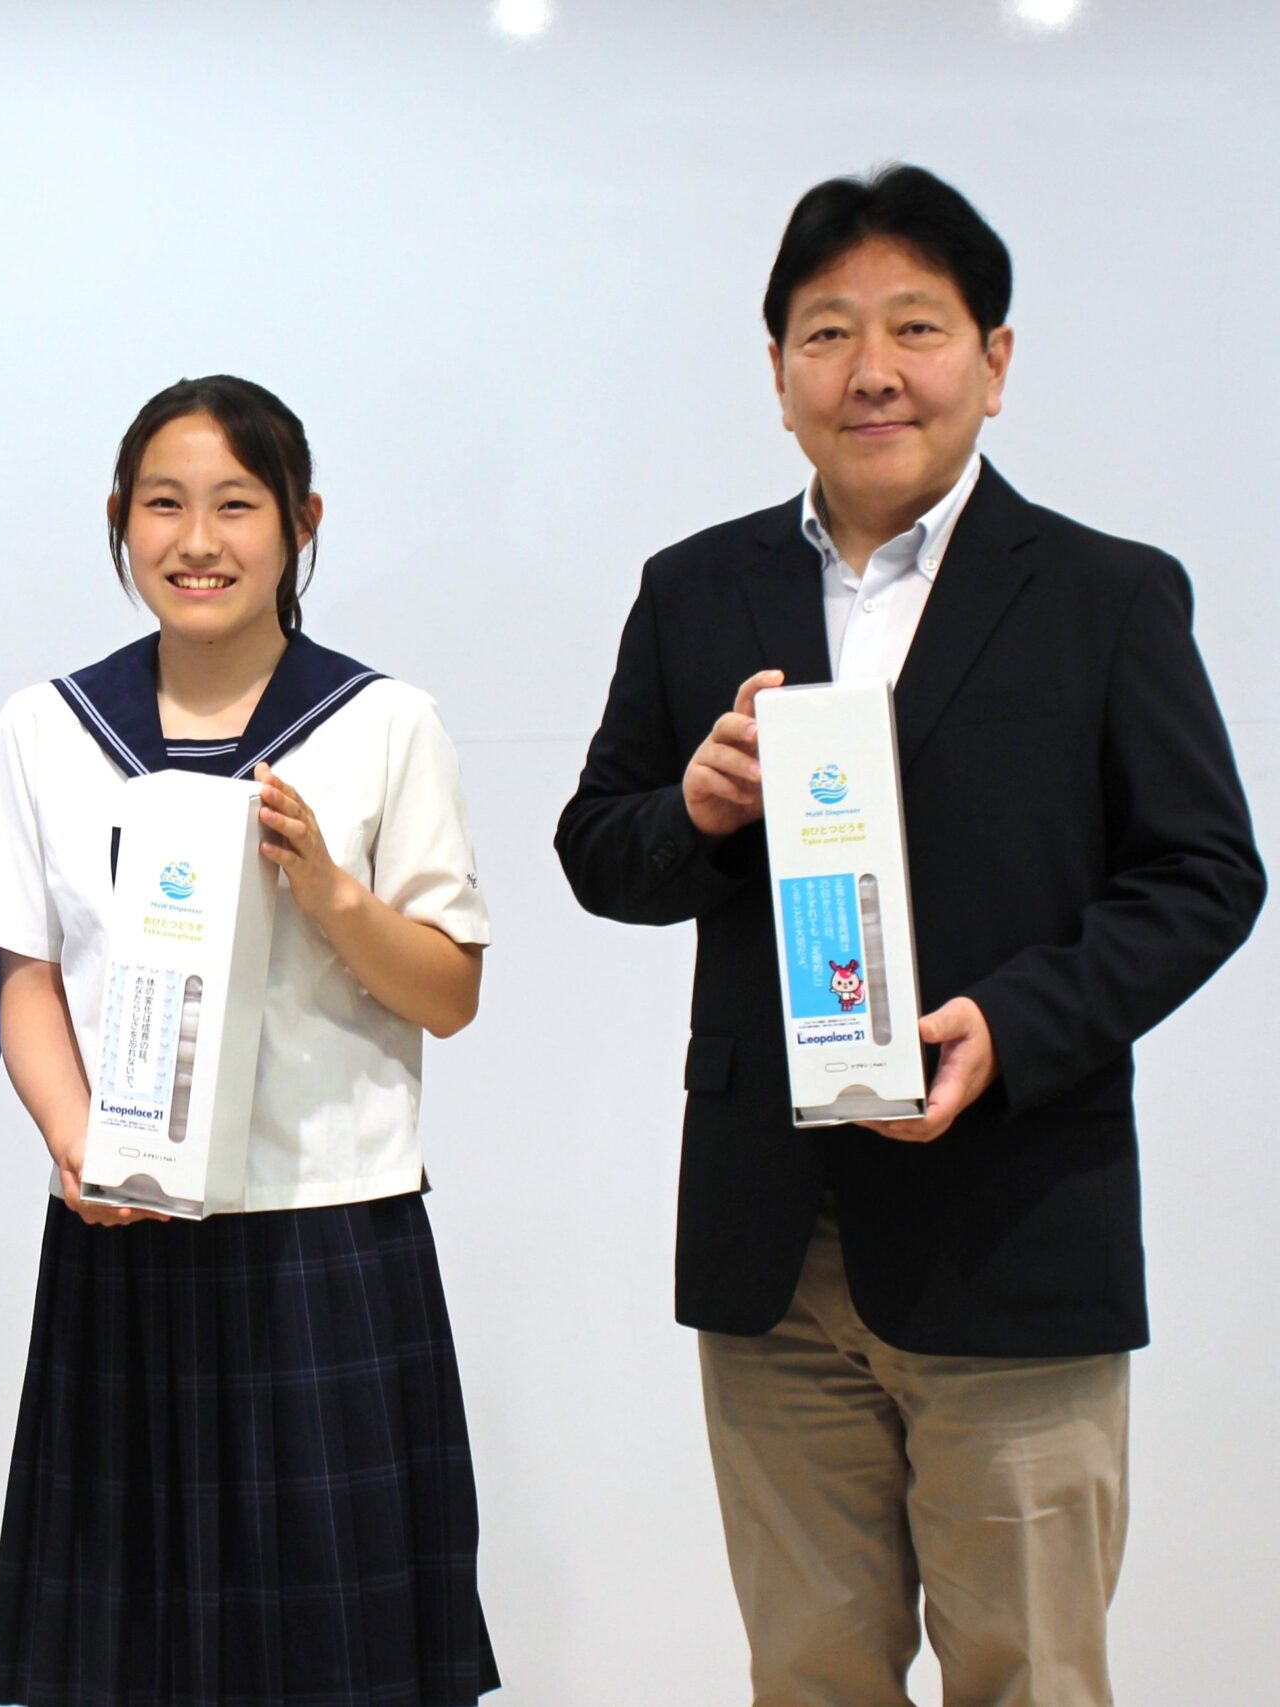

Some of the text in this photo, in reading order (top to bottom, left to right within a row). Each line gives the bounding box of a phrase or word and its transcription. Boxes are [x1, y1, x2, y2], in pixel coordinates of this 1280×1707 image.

[801, 822, 865, 836] おひとつどうぞ
[144, 916, 204, 932] おひとつどうぞ
[797, 1030, 865, 1046] Leopalace 21
[101, 1099, 163, 1120] Leopalace 21
